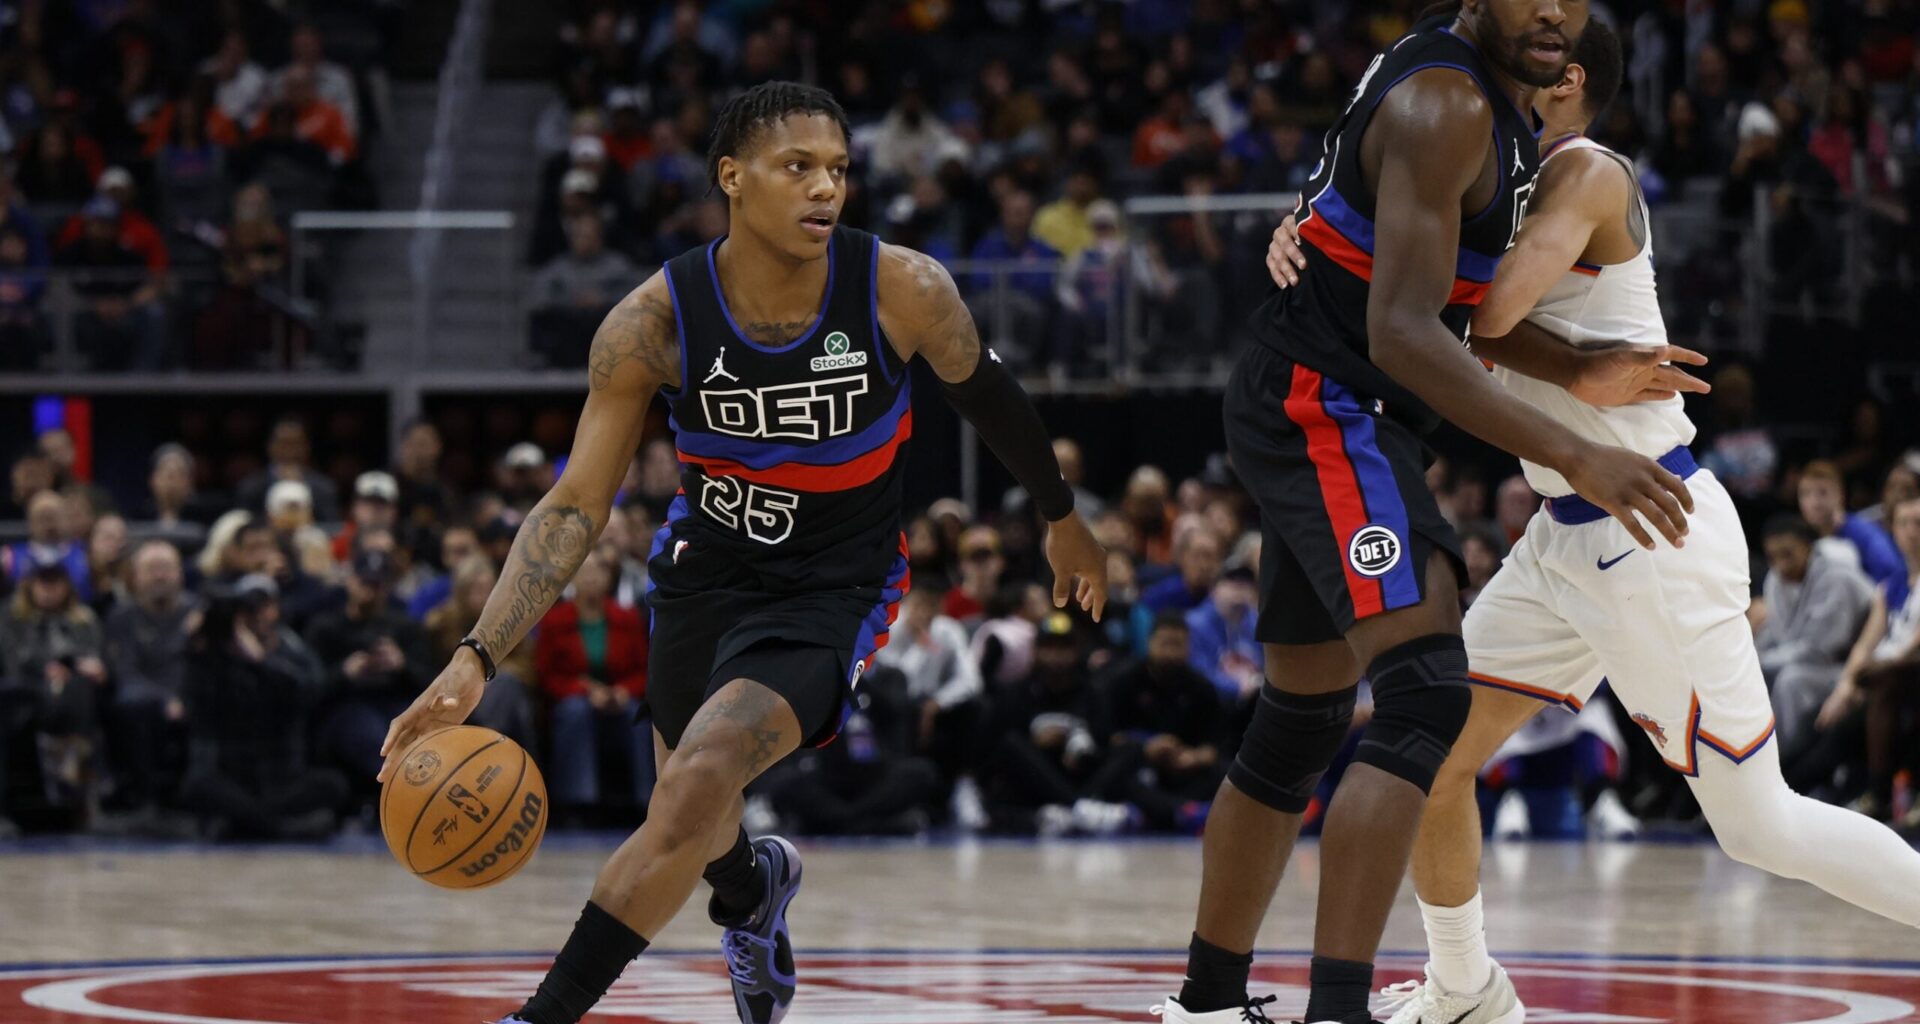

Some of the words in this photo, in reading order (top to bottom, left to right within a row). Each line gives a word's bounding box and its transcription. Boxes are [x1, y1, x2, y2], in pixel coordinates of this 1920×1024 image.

[812, 353, 866, 370] StockX
[700, 373, 868, 440] DET
[700, 474, 799, 545] 25
[1357, 539, 1391, 563] DET
[457, 791, 543, 877] Wilson
